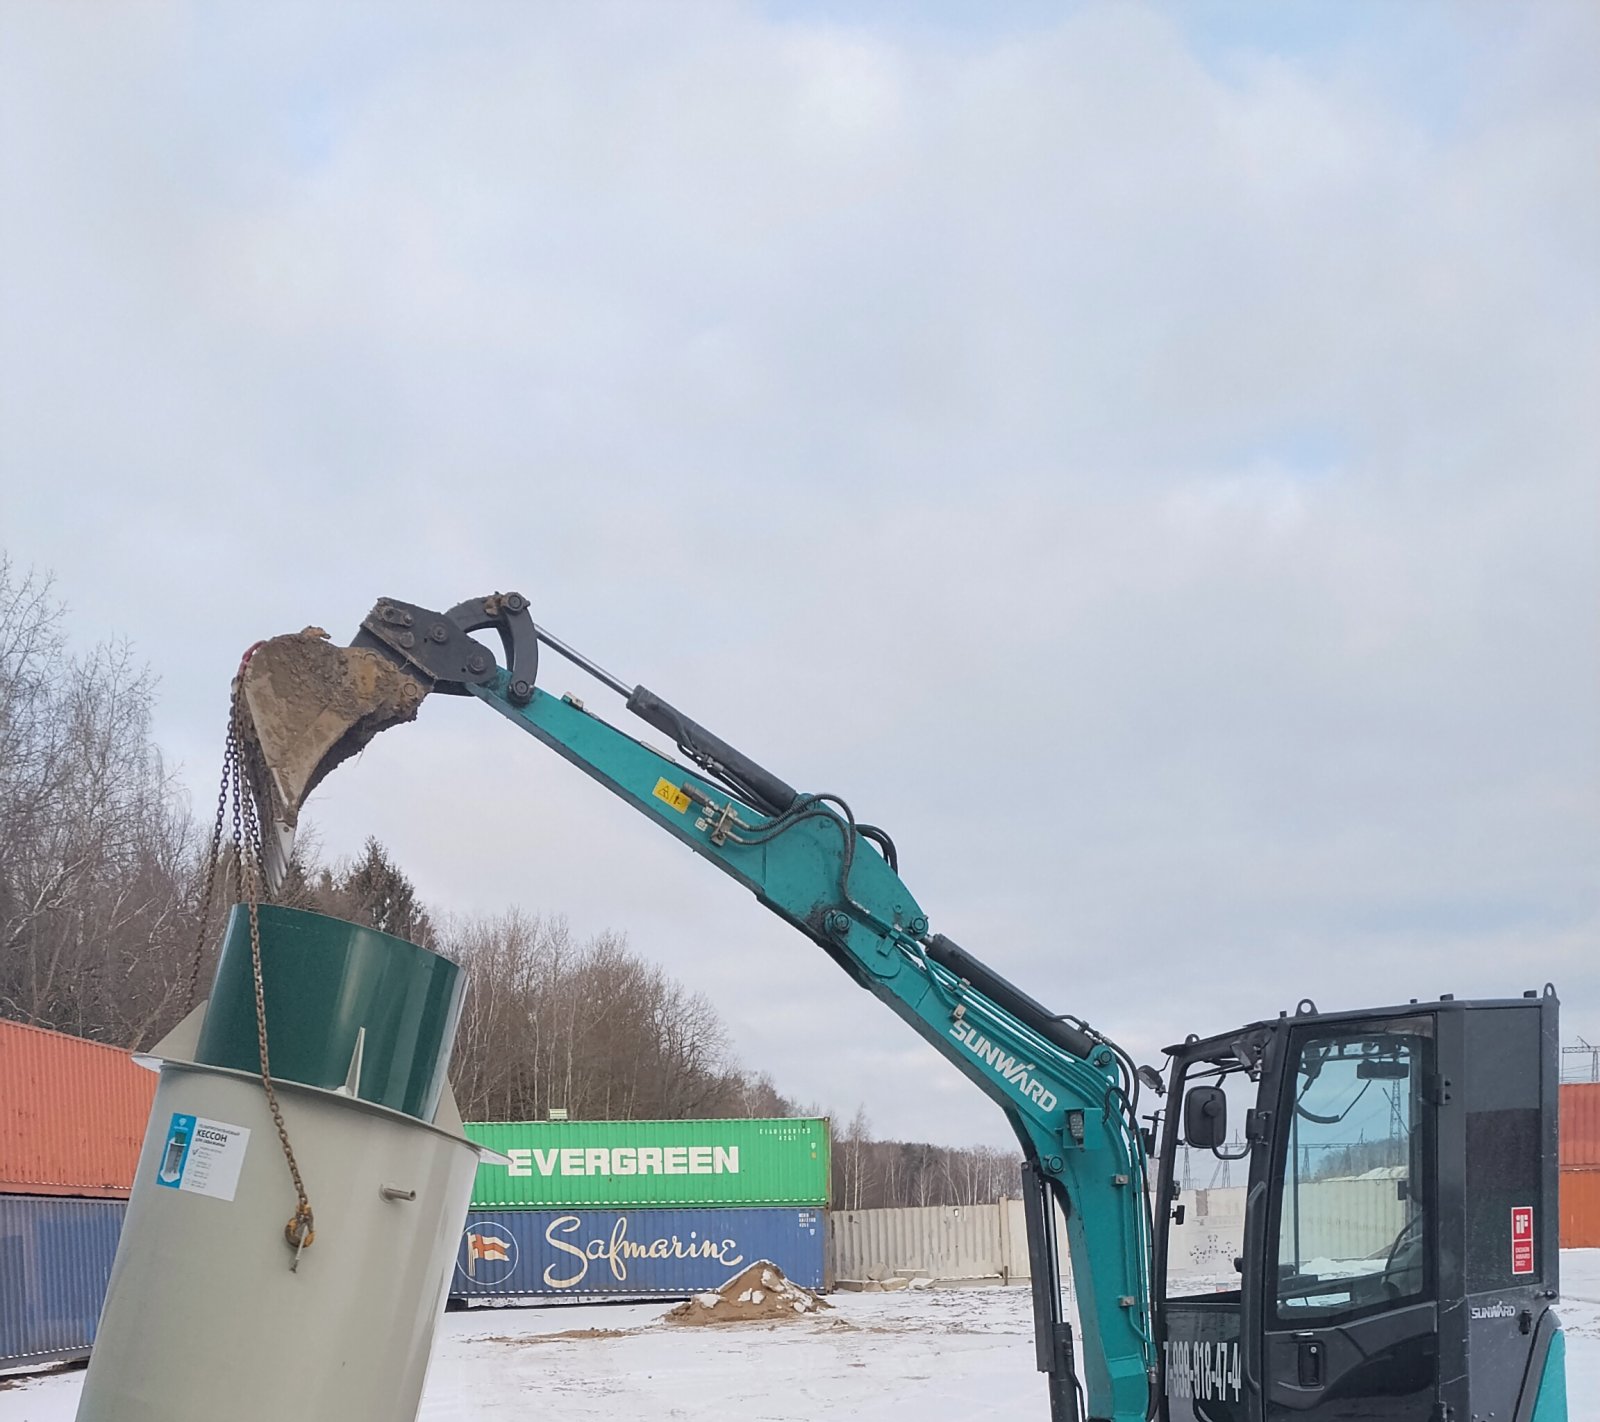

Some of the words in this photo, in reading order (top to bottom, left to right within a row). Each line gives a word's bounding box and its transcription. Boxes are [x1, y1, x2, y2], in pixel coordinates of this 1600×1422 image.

[949, 1019, 1057, 1112] SUNWARD
[196, 1129, 228, 1143] КЕССОН
[507, 1146, 739, 1176] EVERGREEN
[543, 1215, 743, 1288] Safmarine
[1471, 1301, 1516, 1319] SUNWARD
